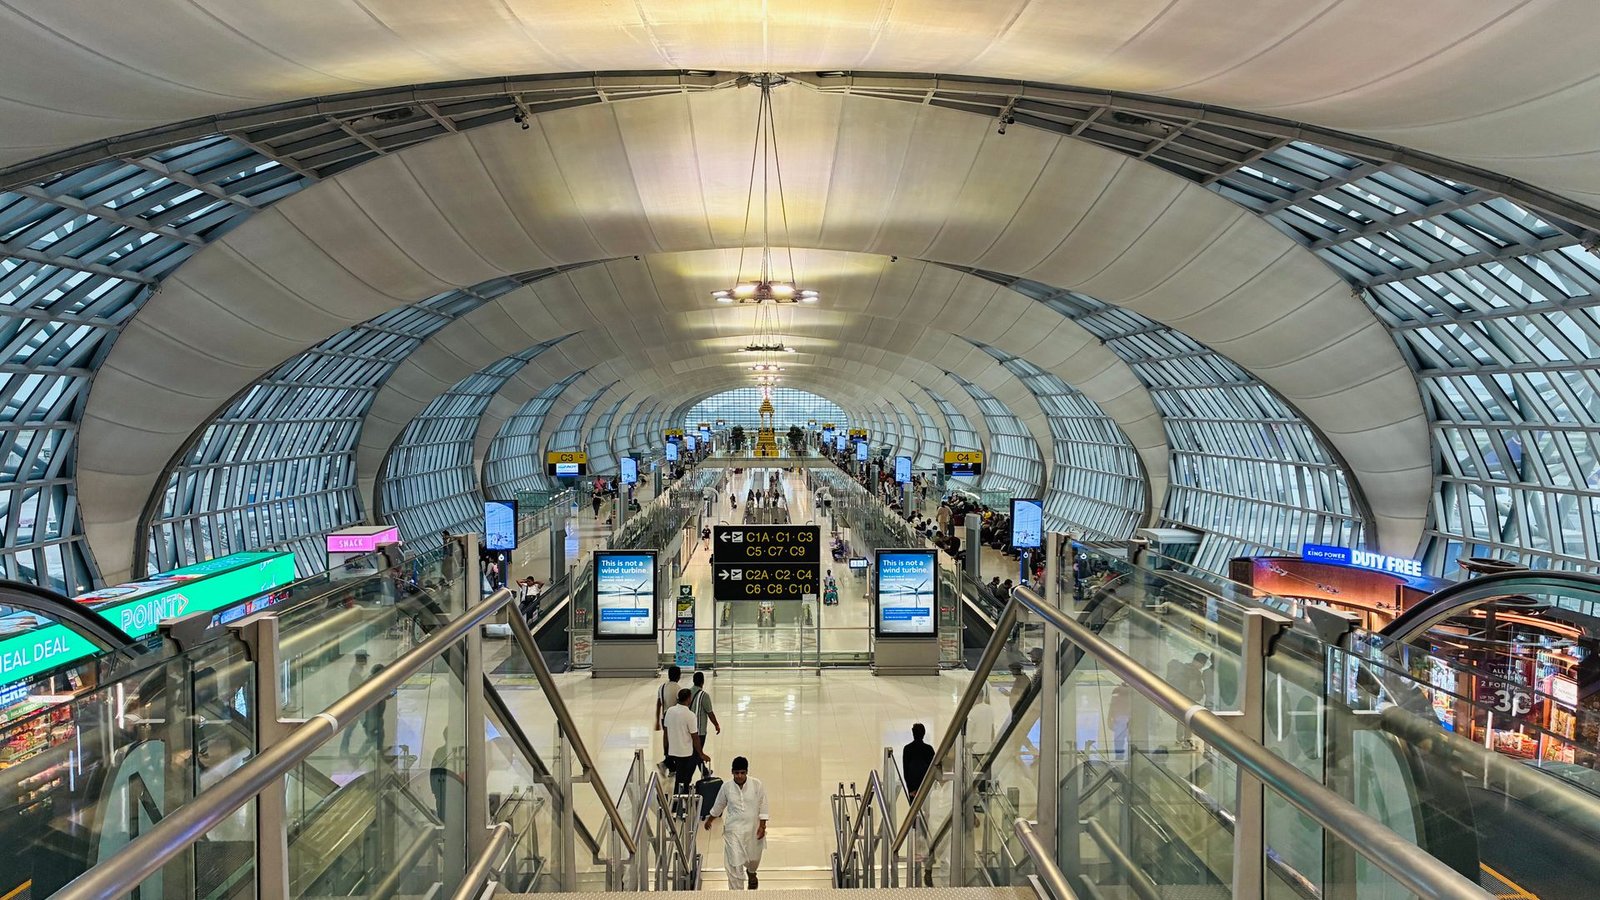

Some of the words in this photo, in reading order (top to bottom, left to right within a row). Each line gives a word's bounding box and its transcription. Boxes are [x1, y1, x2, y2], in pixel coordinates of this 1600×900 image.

[560, 453, 574, 462] C3
[956, 453, 970, 462] C4
[746, 531, 770, 543] C1A
[775, 531, 790, 543] C1
[797, 531, 814, 543] C3
[746, 545, 762, 557] C5
[767, 545, 784, 557] C7
[789, 545, 806, 557] C9
[1307, 549, 1323, 557] KING
[1323, 552, 1346, 560] POWER
[1351, 549, 1386, 570] DUTY
[1387, 556, 1422, 577] FREE
[745, 569, 769, 581] C2A
[774, 569, 791, 581] C2
[796, 569, 813, 581] C4
[745, 583, 761, 595] C6
[766, 583, 783, 595] C8
[788, 583, 811, 595] C10
[121, 595, 177, 631] POINT
[0, 648, 31, 674] EAL
[33, 635, 70, 662] DEAL
